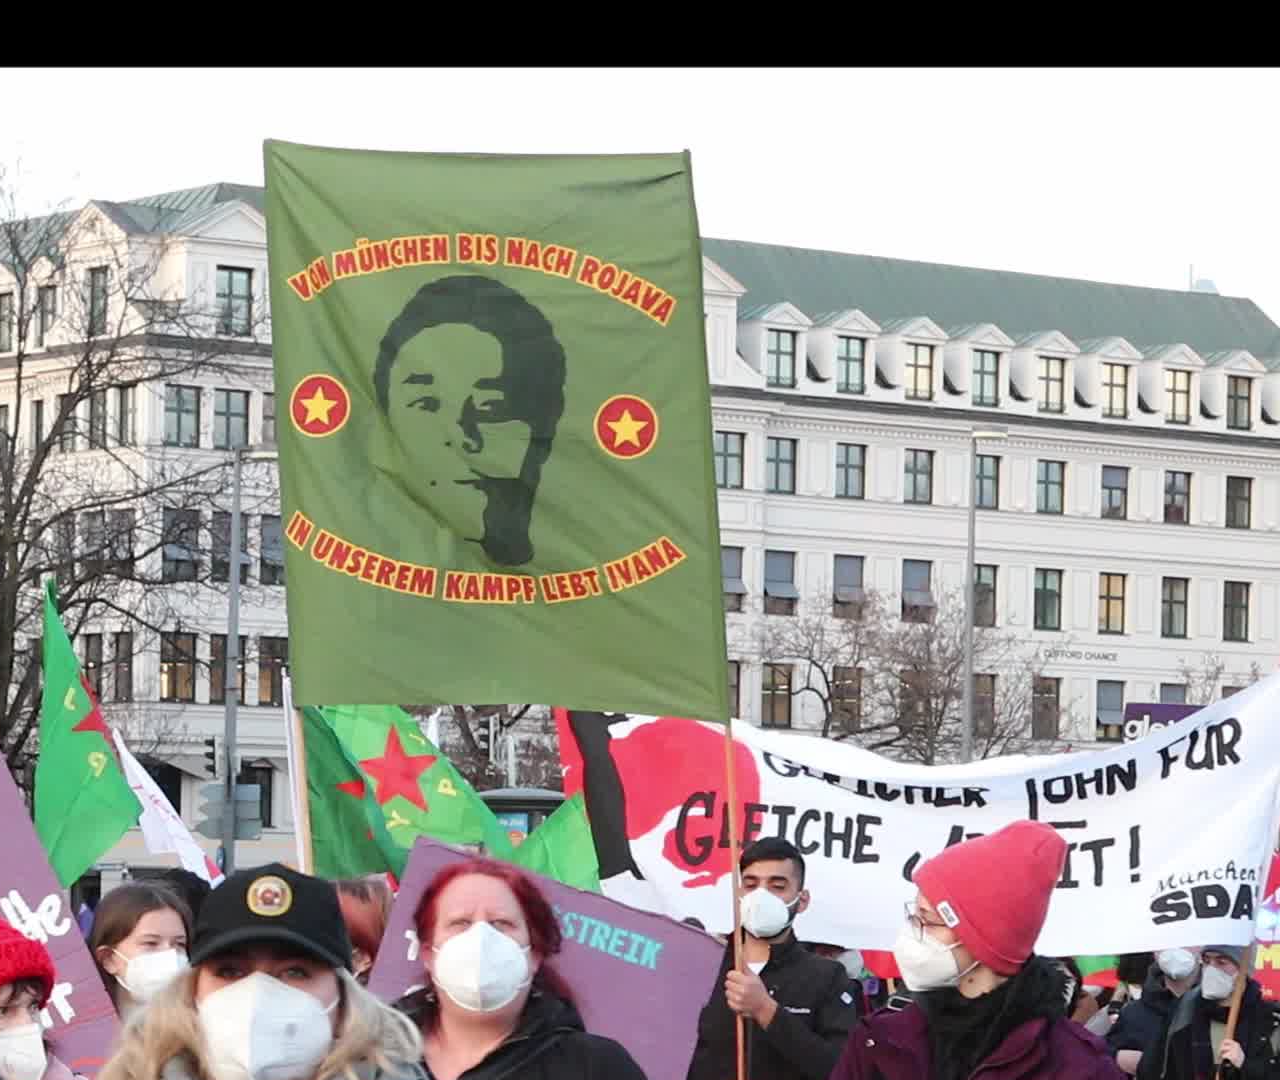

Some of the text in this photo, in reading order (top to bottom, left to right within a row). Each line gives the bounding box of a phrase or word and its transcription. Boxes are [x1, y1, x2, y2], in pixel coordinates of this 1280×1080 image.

[288, 234, 677, 327] VON MÜNCHEN BIS NACH ROJAVA
[285, 510, 687, 604] IN UNSEREM KAMPF LEBT IVANA
[675, 791, 882, 866] GLEICHE
